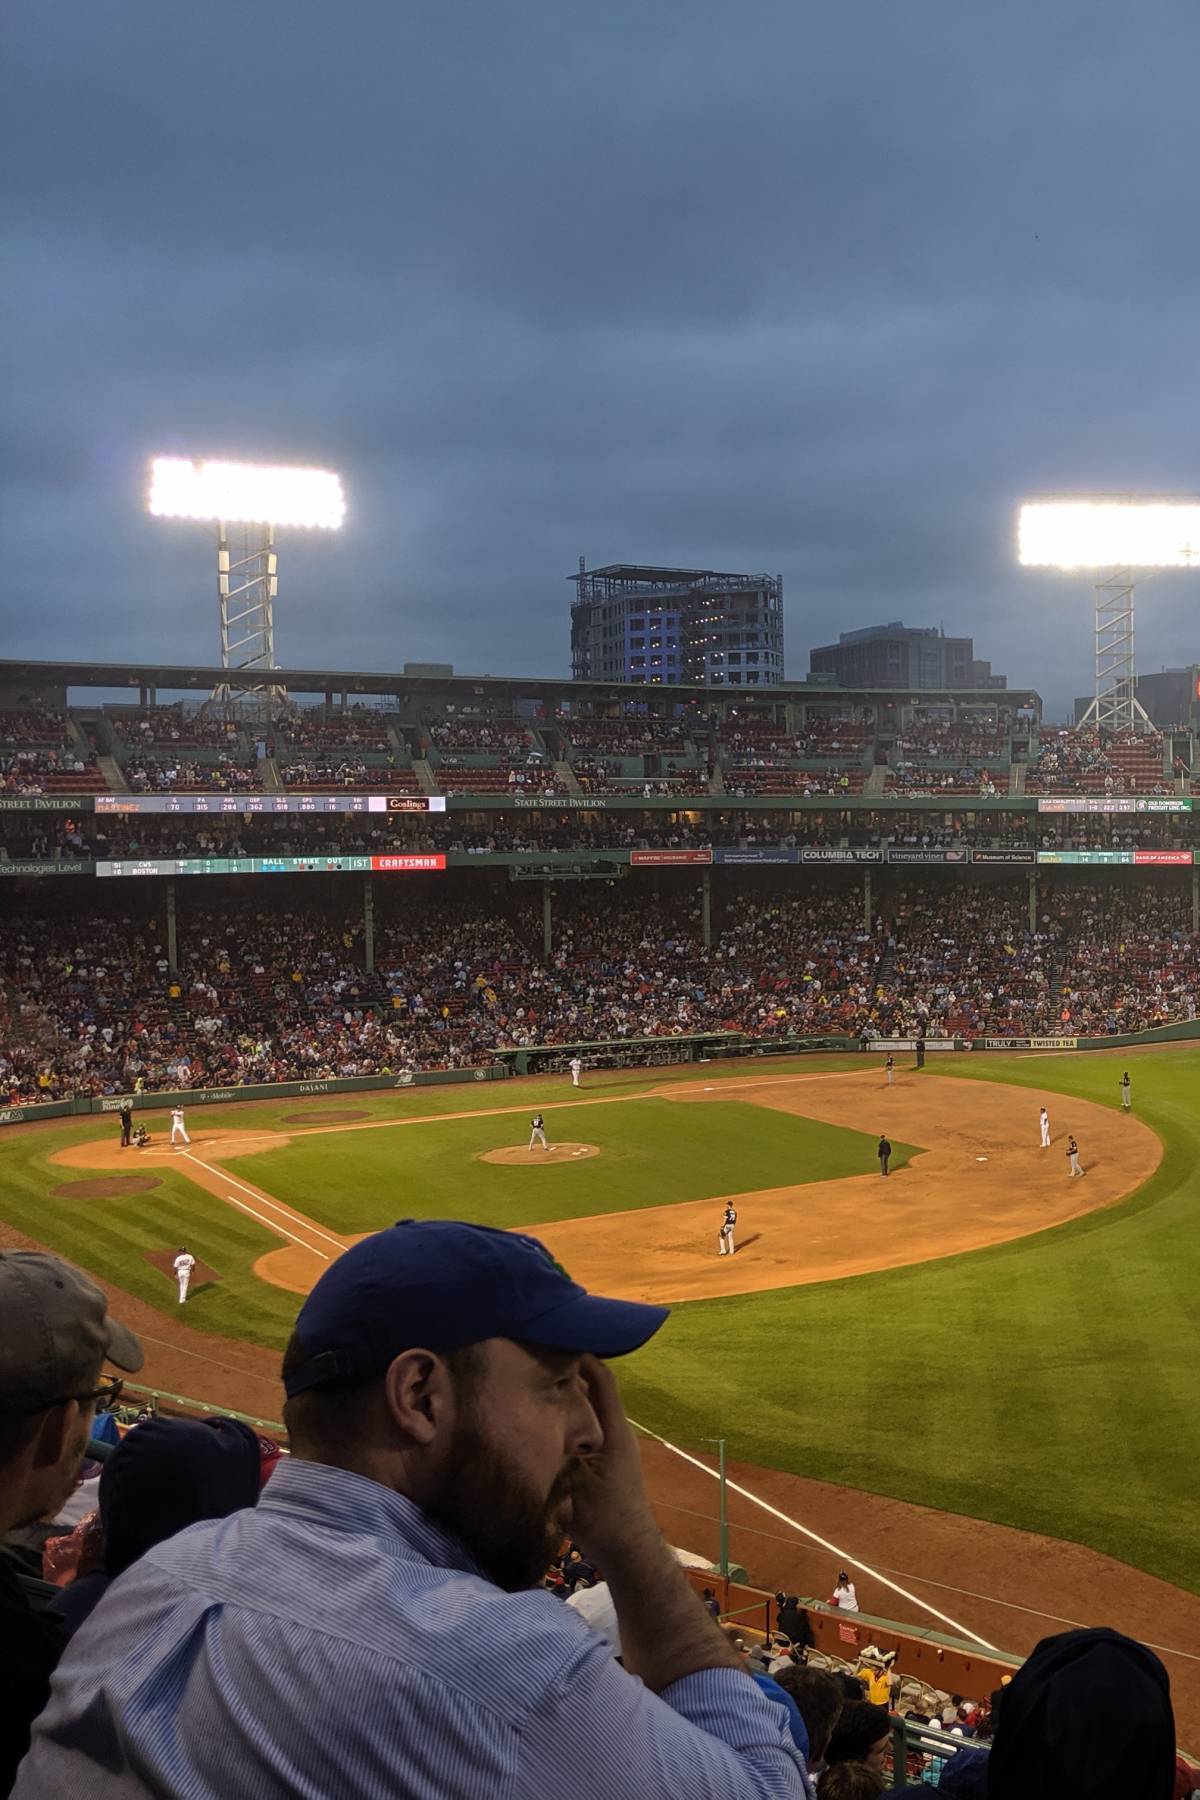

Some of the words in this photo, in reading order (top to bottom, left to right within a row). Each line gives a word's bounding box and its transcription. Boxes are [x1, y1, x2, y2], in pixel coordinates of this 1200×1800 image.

[35, 799, 80, 808] PAVILION
[539, 799, 567, 807] STREET
[569, 799, 606, 807] PAVILION
[891, 850, 924, 861] vineyard
[925, 850, 944, 859] vines
[380, 858, 437, 868] CRAFTSMAN
[300, 1084, 328, 1092] DASANI
